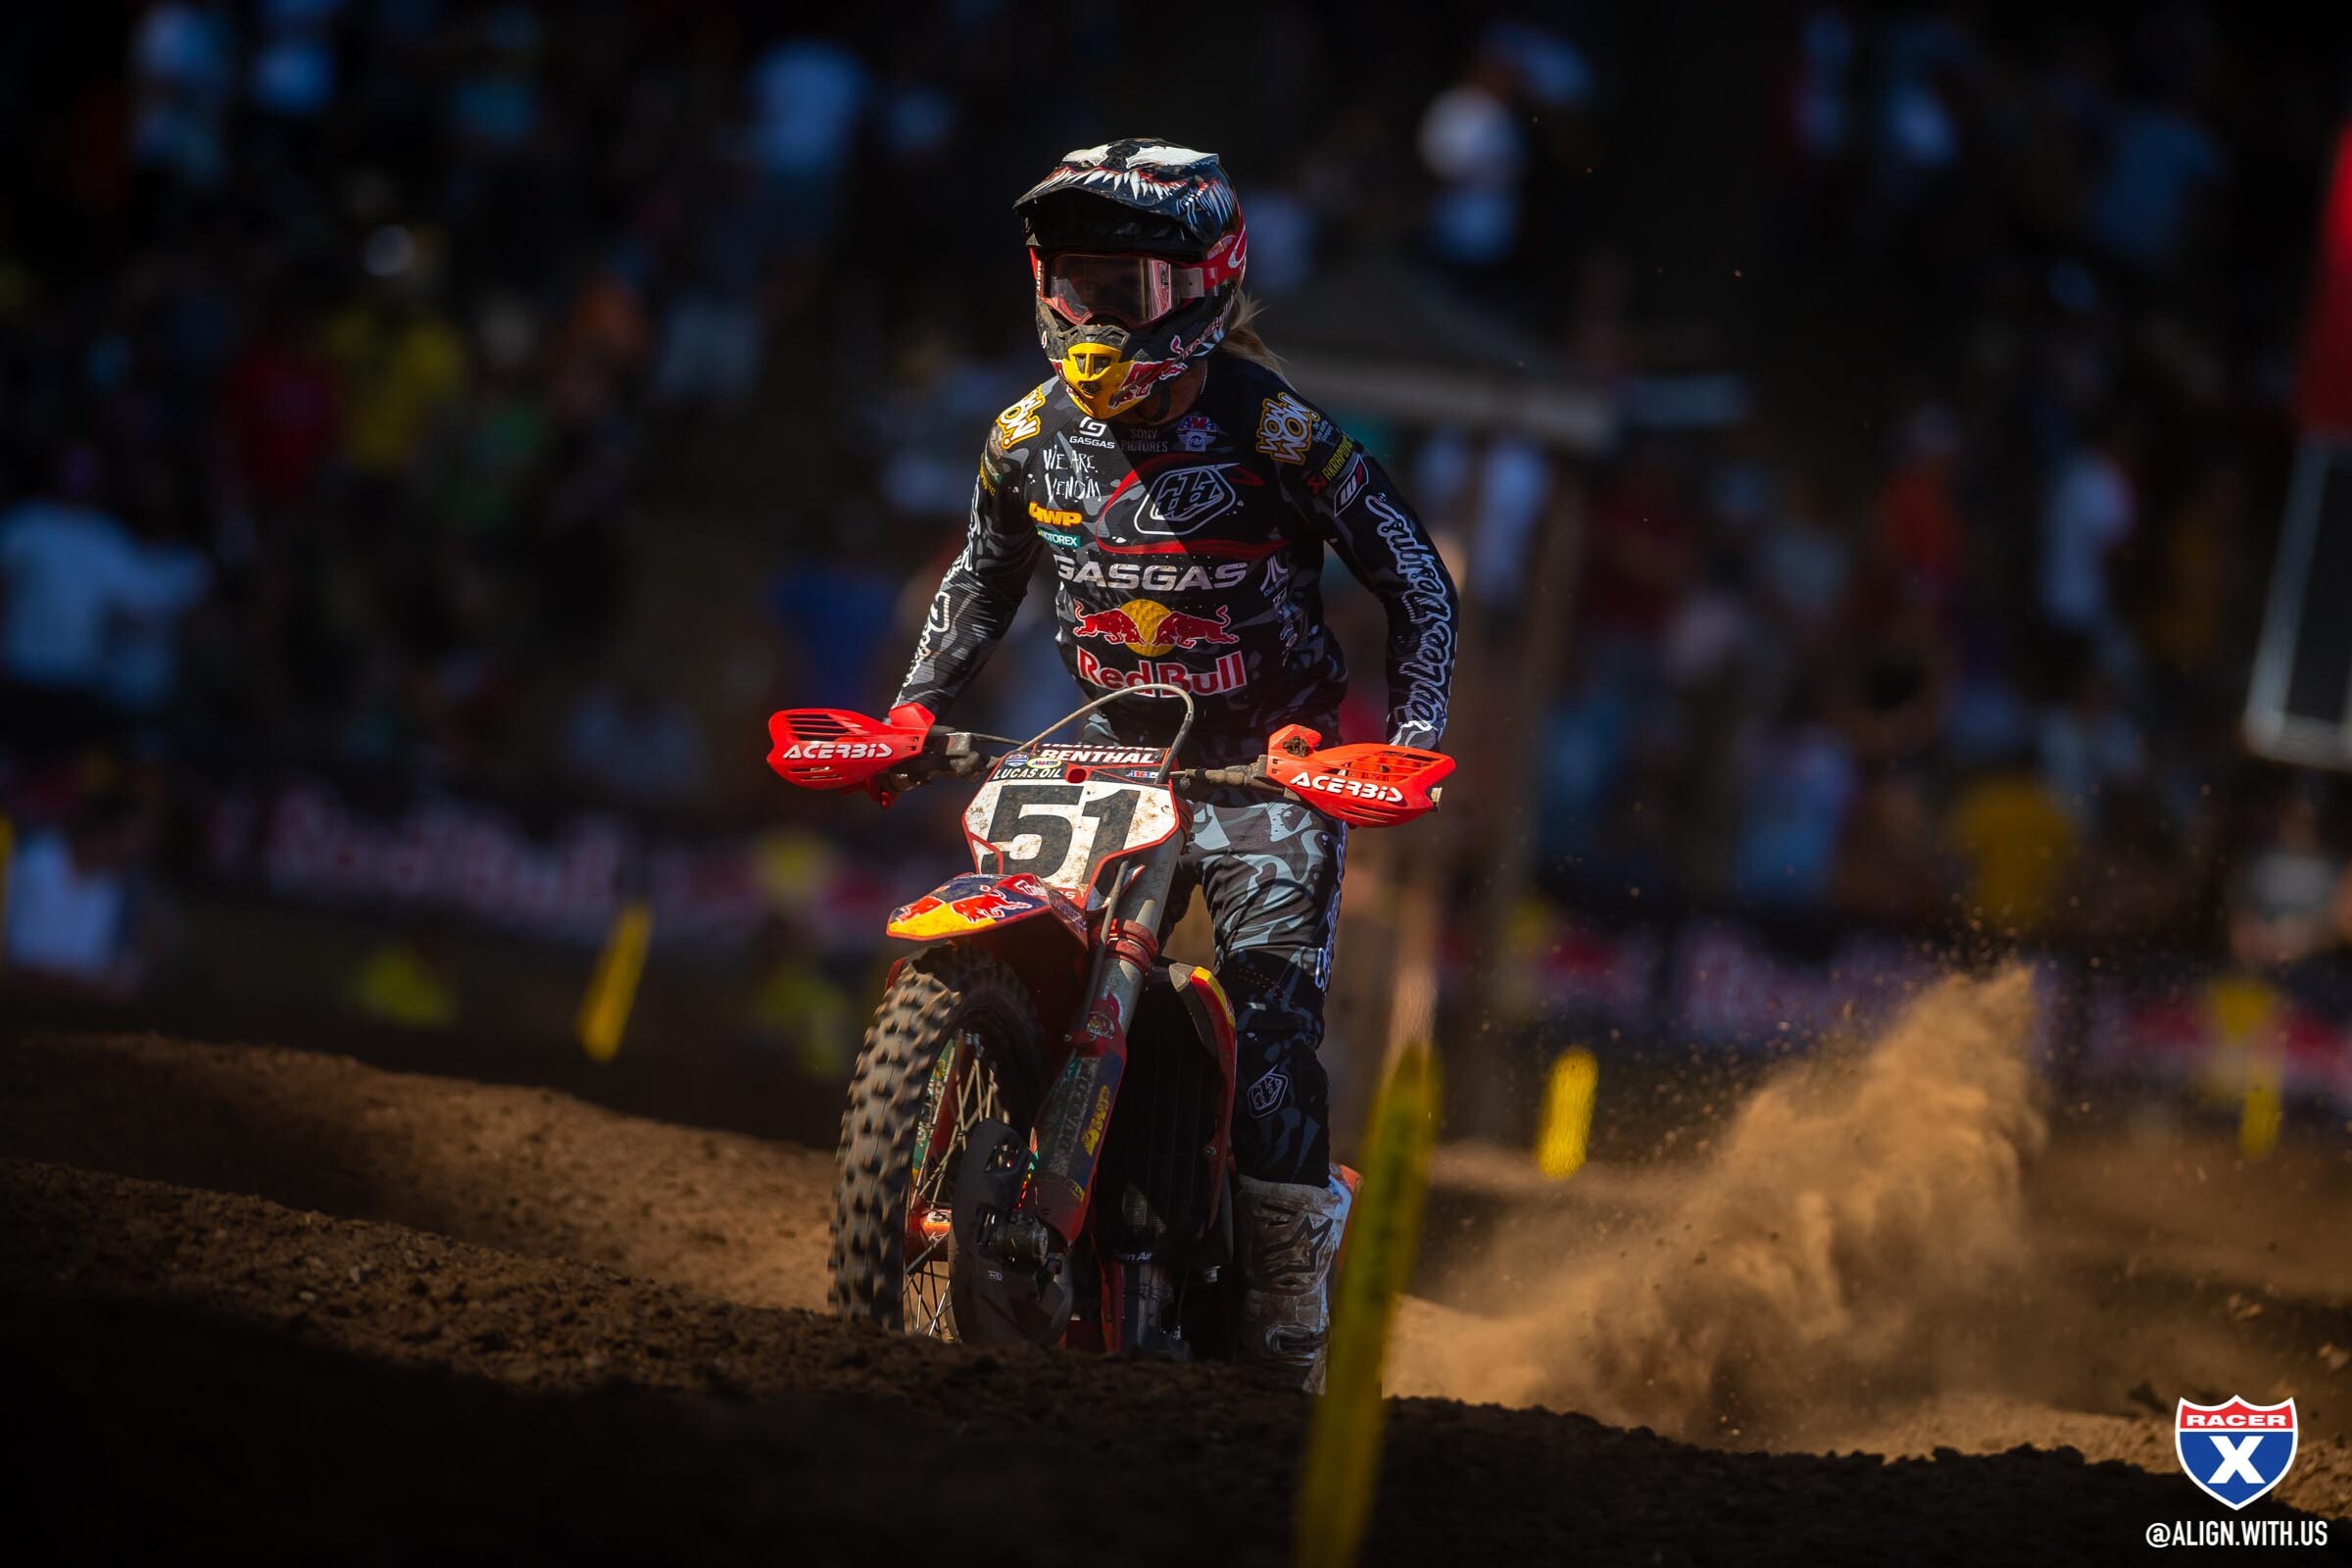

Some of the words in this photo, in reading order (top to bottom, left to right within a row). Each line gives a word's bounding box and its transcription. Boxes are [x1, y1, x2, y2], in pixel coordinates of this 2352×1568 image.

[1069, 435, 1115, 450] GASGAS
[1121, 439, 1168, 453] PICTURES
[1129, 428, 1157, 440] SONY
[1043, 444, 1068, 470] WE
[1044, 472, 1102, 503] VENOM
[1054, 553, 1248, 592] GASGAS
[1076, 644, 1156, 699] Red
[1156, 650, 1249, 699] Bull
[993, 767, 1039, 780] LUCAS
[1039, 767, 1062, 778] OIL
[981, 785, 1141, 883] 51
